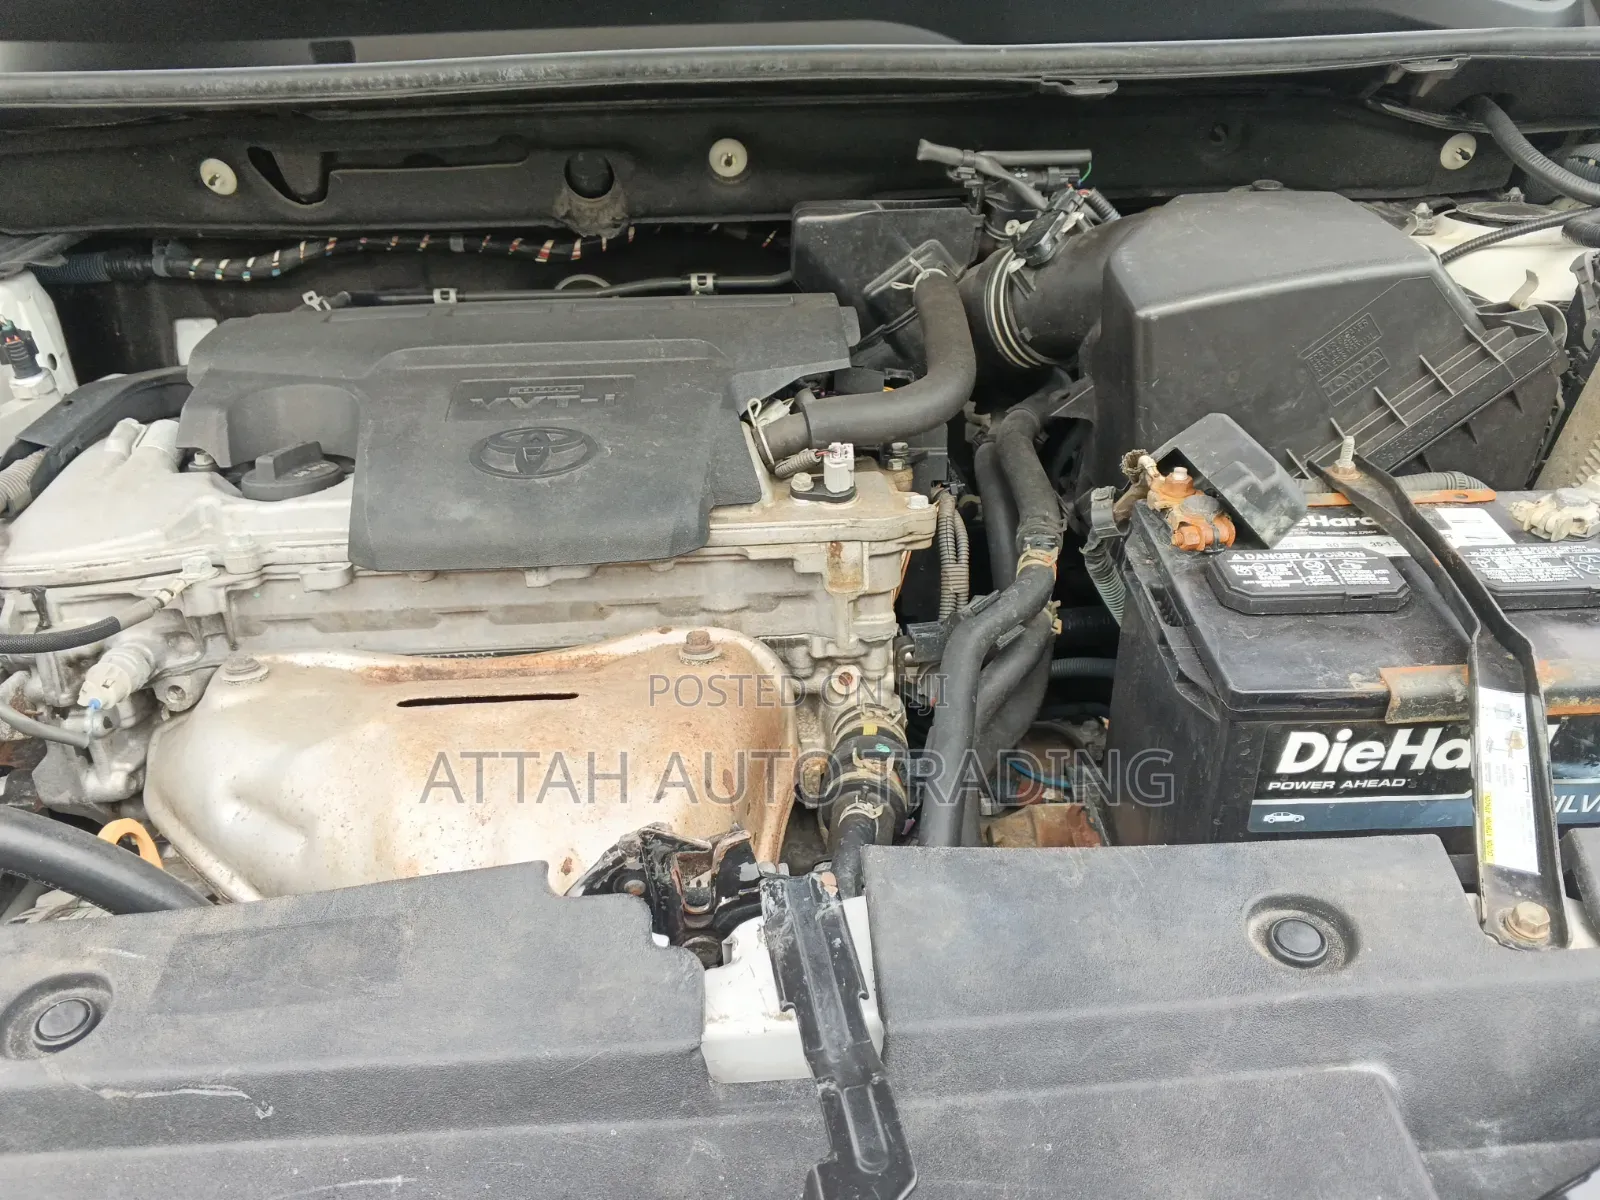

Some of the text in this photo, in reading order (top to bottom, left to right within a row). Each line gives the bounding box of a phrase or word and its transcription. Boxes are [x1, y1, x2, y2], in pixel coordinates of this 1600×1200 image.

[1244, 551, 1301, 561] DANGER
[1314, 550, 1366, 560] POISON
[1275, 728, 1472, 775] DieHa
[1267, 778, 1406, 791] POWER AHEAD
[1554, 794, 1600, 813] ILV
